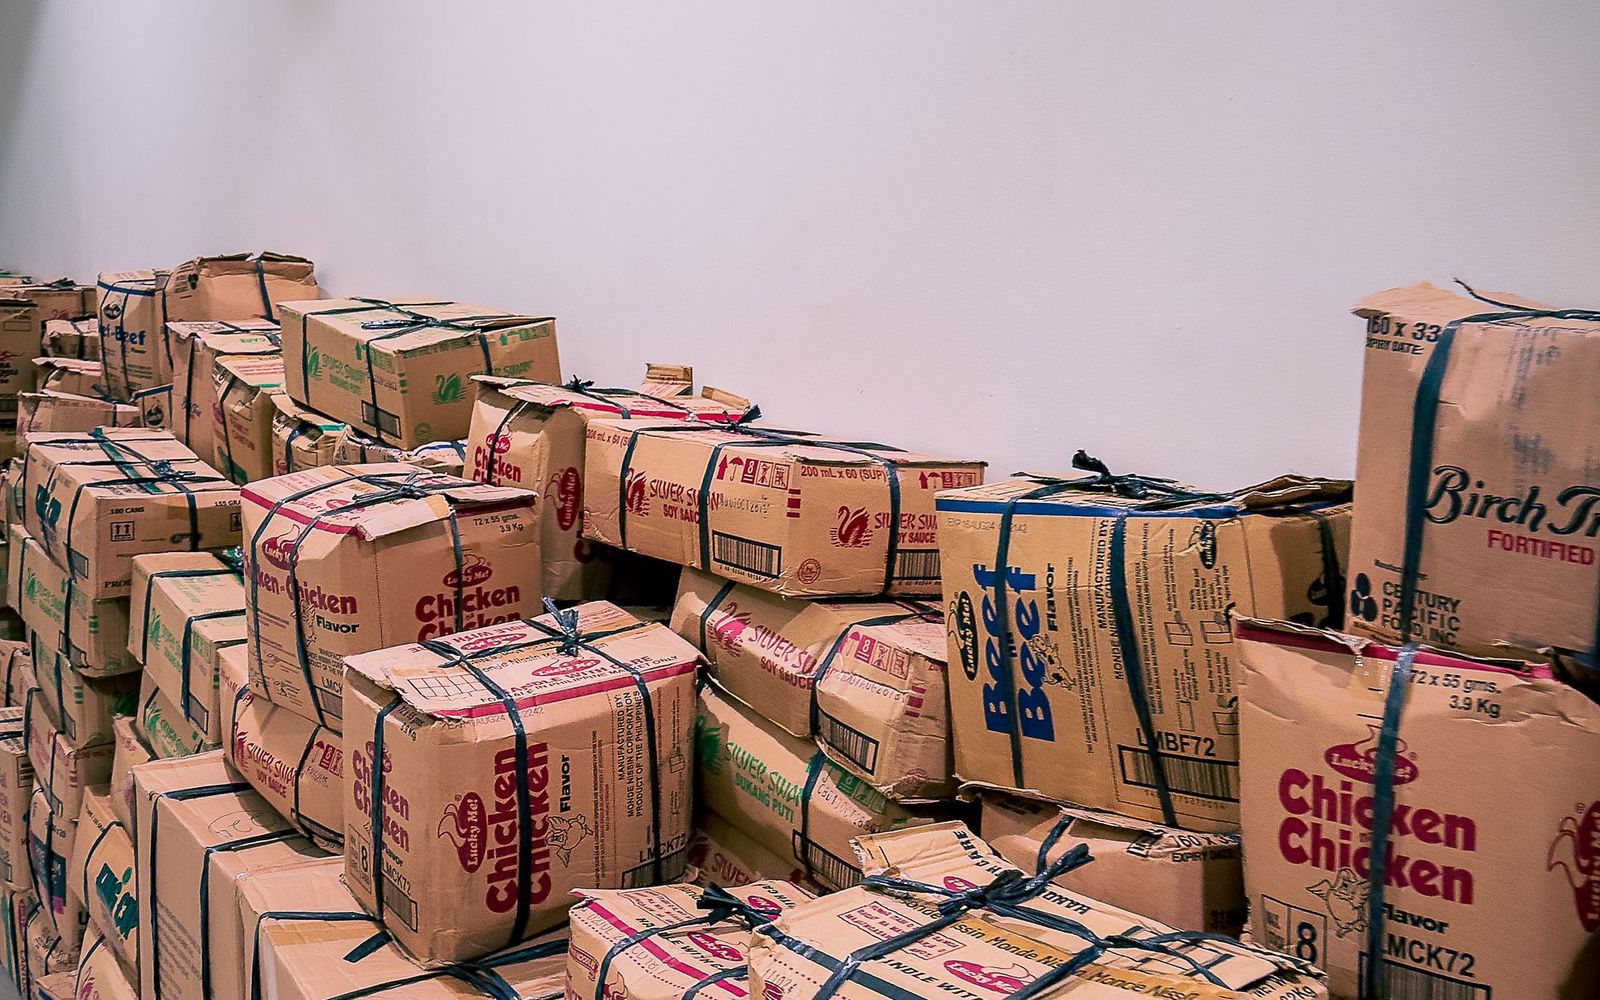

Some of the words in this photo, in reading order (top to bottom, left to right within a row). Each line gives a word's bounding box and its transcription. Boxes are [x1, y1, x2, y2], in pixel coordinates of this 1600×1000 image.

[475, 446, 521, 482] Chcken
[800, 465, 820, 478] 200
[820, 467, 837, 479] mL
[837, 470, 845, 478] x
[846, 468, 858, 479] 60
[859, 468, 886, 483] (SUP)
[650, 479, 685, 503] SILVER
[1424, 465, 1547, 532] Birch
[473, 518, 484, 526] 72
[491, 516, 500, 524] 55
[500, 525, 511, 533] 3.9
[511, 522, 524, 532] Kg
[663, 505, 676, 518] SOY
[679, 507, 700, 524] SAUC
[874, 512, 914, 529] SILER
[1098, 519, 1110, 537] BY:
[264, 544, 282, 560] Lucky
[1487, 529, 1595, 566] FORTIFIED
[1046, 562, 1059, 632] Flavor
[1095, 537, 1108, 629] MANUFACTURED
[1383, 581, 1461, 613] CETURY
[415, 586, 521, 622] Chcken
[315, 614, 360, 635] Flavor
[748, 625, 794, 663] SILVER
[962, 628, 976, 675] Lucky
[973, 563, 1010, 734] Beef
[1006, 566, 1056, 742] Beef
[540, 665, 574, 677] Lucky
[548, 673, 608, 688] PHILIPPINE
[652, 655, 678, 667] ONLY
[760, 656, 777, 677] SOY
[777, 666, 814, 690] SAUCE
[1410, 669, 1426, 684] 72
[1429, 674, 1439, 686] x
[1442, 673, 1461, 688] 55
[1462, 674, 1501, 693] gms.
[614, 694, 625, 709] BY:
[633, 690, 643, 741] PHILIPPINES
[1449, 694, 1473, 710] 3.9
[1477, 698, 1501, 719] Kg
[623, 692, 634, 754] CORPORATION
[246, 743, 275, 773] SILVER
[616, 711, 626, 781] MANUFACTURED
[634, 742, 643, 759] THE
[626, 756, 634, 784] NISSIN
[635, 762, 643, 774] OF
[727, 742, 767, 783] SILVER
[1332, 753, 1375, 778] Lucky
[560, 754, 571, 813] Flavor
[635, 776, 643, 817] PRODUCT
[467, 797, 479, 823] Me!
[627, 785, 635, 817] MONDE
[772, 799, 795, 823] PUTI
[467, 823, 481, 866] Lucky
[486, 748, 518, 913] Chicken
[360, 845, 369, 873] 8
[986, 931, 1039, 960] Monde
[1296, 921, 1317, 964] 8
